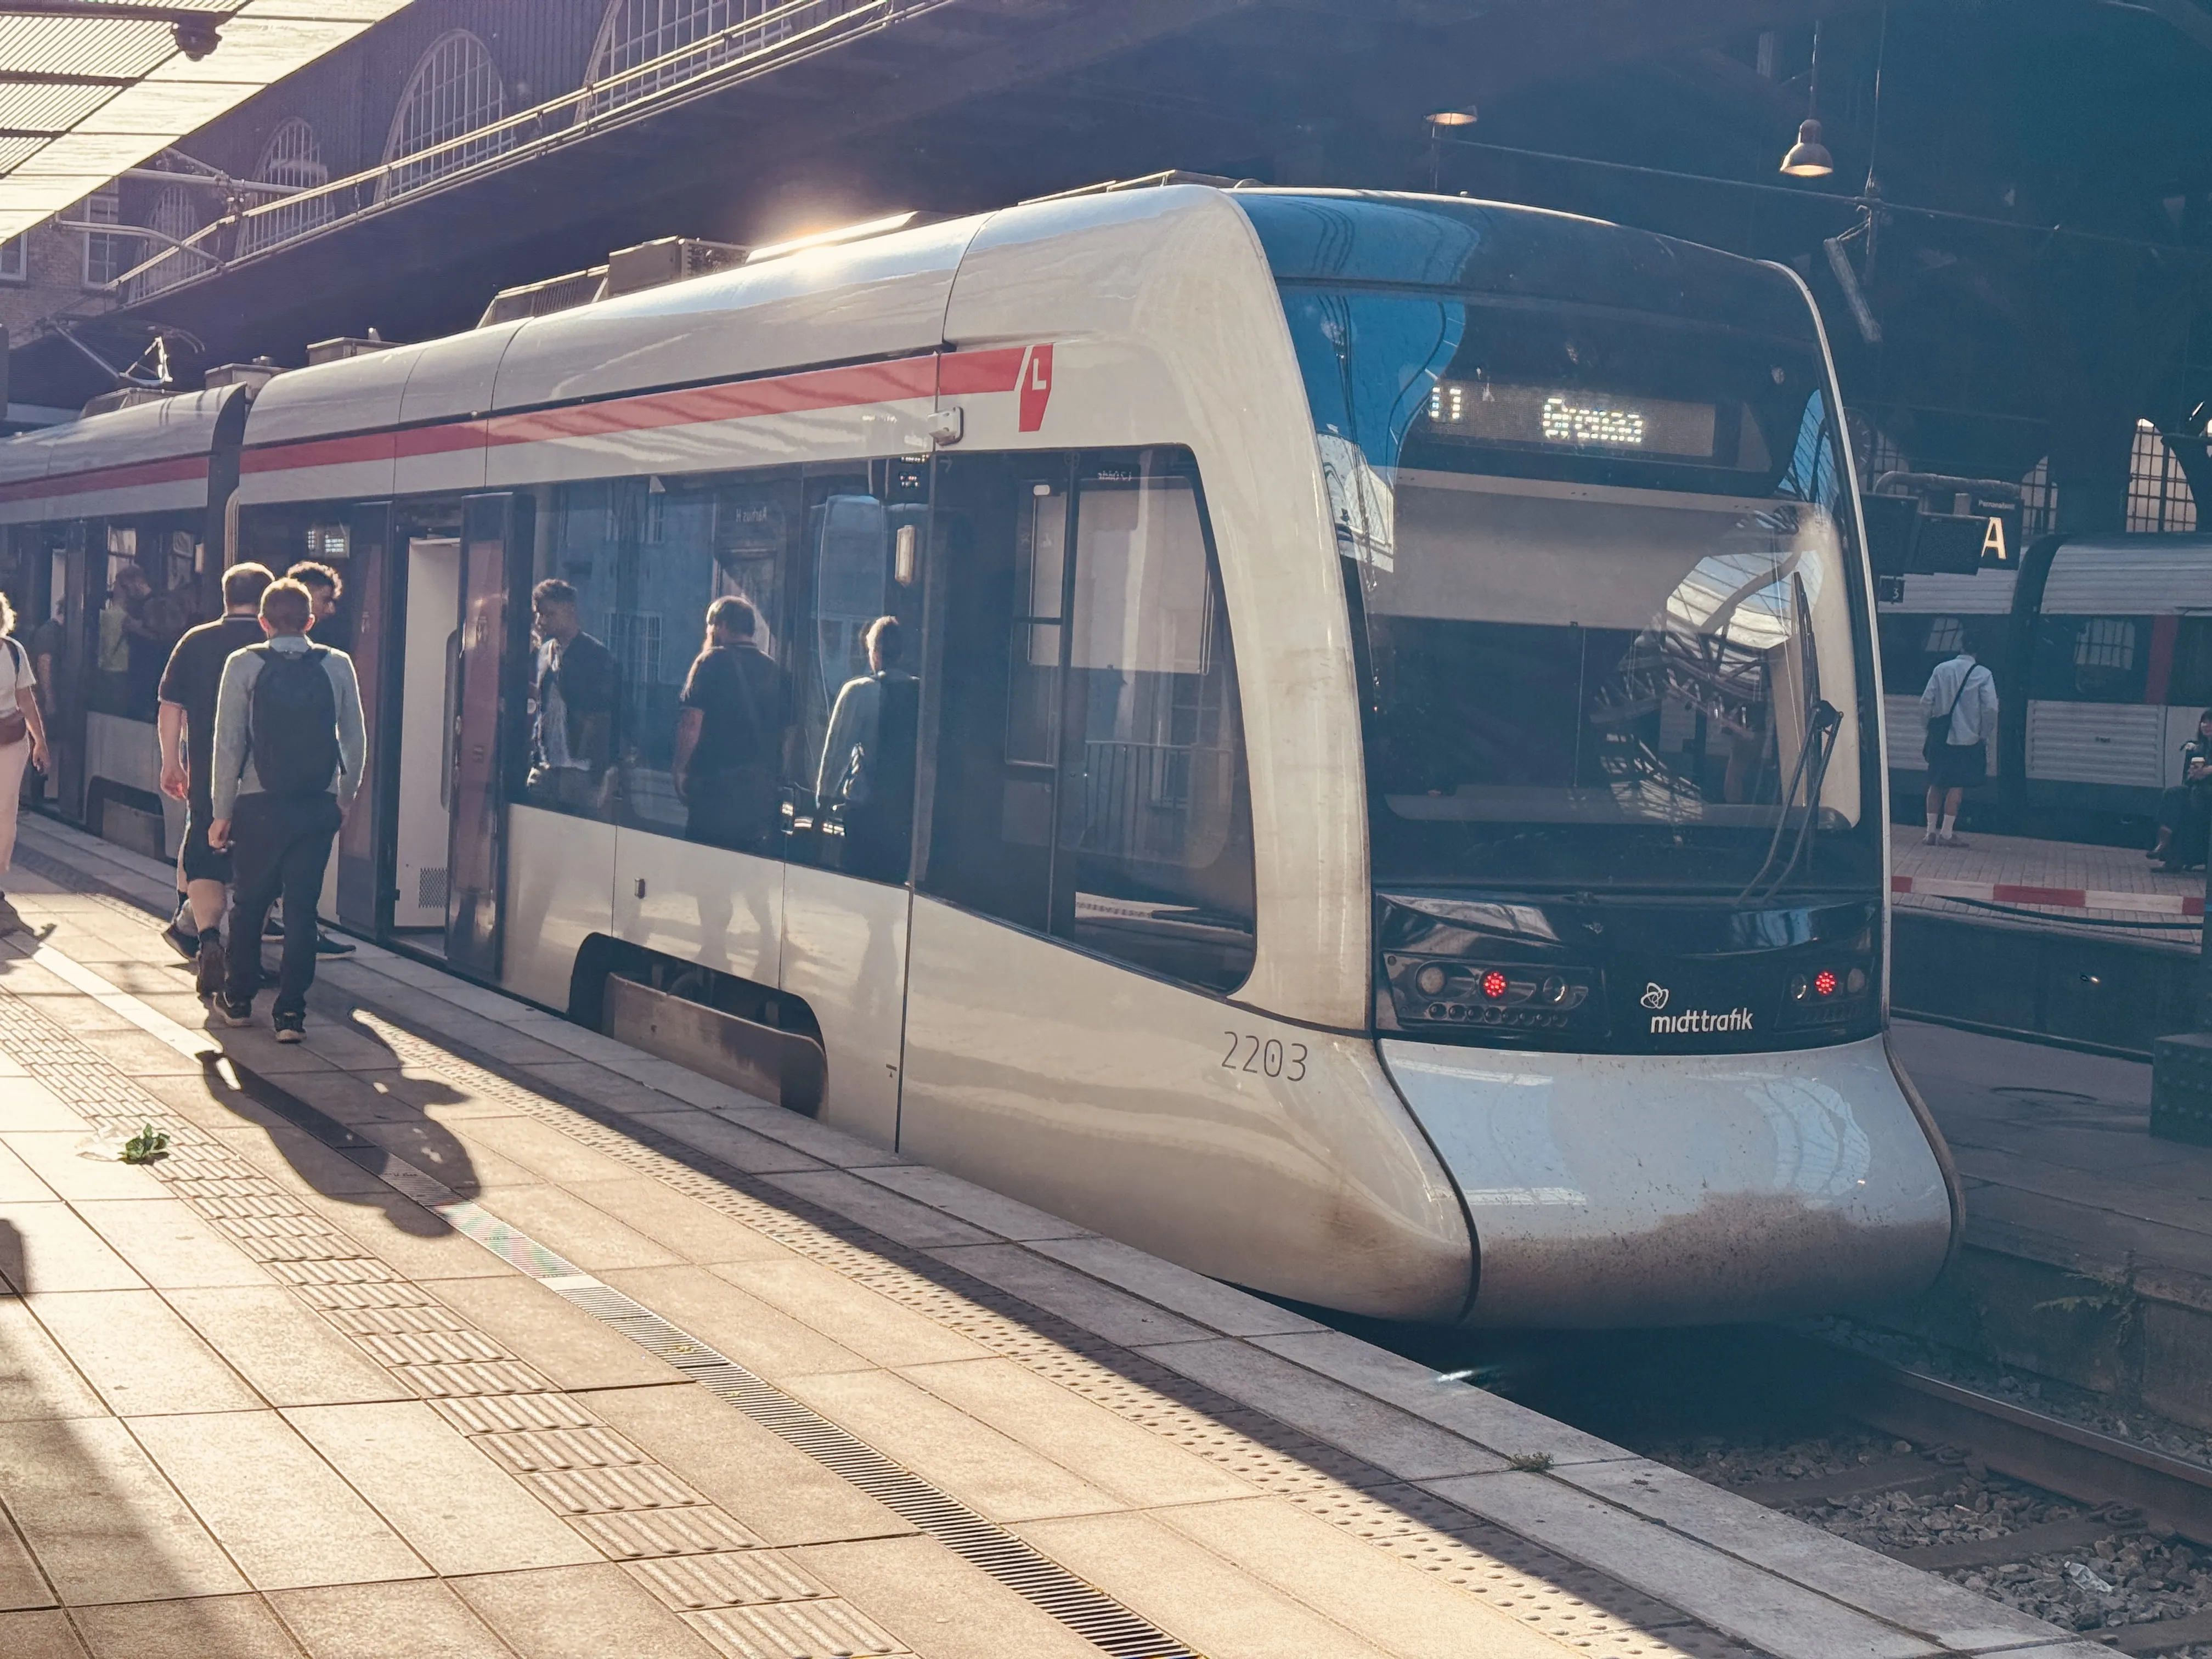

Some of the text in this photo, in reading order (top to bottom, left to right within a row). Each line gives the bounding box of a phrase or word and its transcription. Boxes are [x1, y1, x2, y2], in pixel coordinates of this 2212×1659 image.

[1980, 516, 2007, 560] A
[1893, 587, 1899, 599] 3
[1650, 1007, 1754, 1034] midttrafik
[1221, 1031, 1308, 1081] 2203
